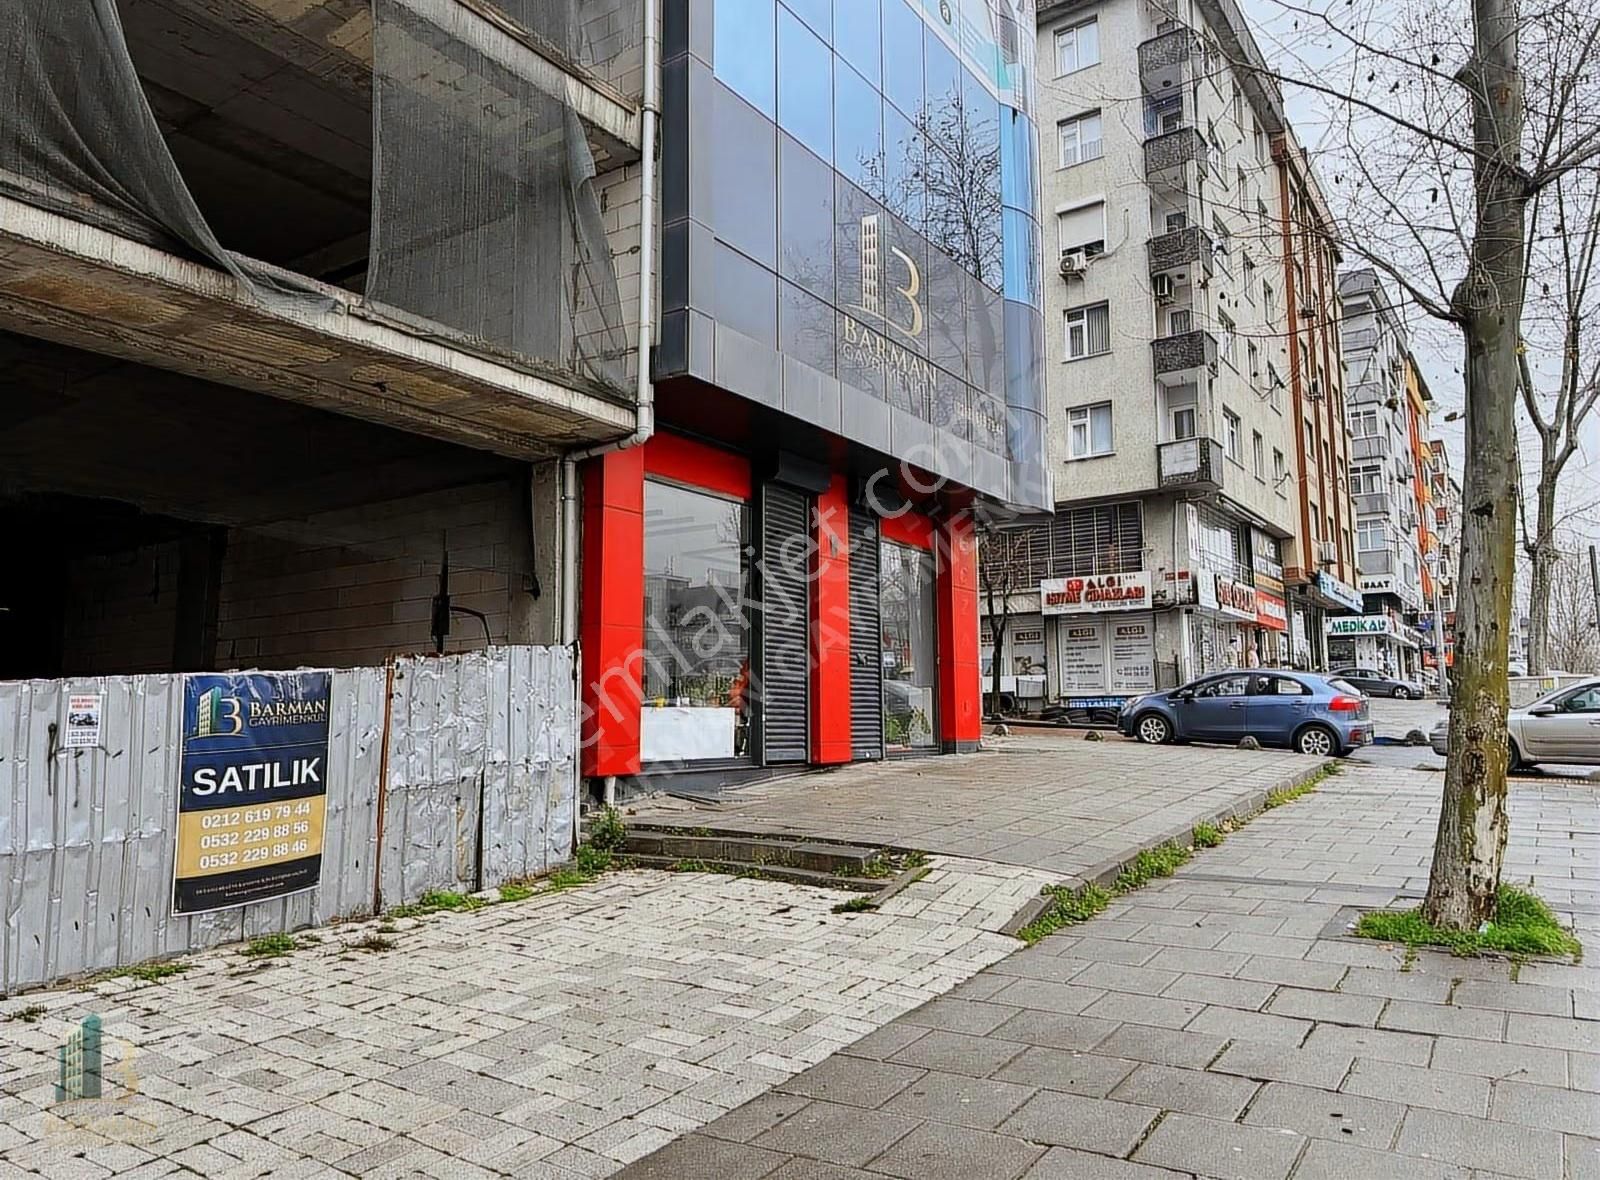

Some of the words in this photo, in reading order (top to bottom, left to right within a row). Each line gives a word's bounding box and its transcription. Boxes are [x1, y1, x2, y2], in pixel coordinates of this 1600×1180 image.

[844, 315, 937, 389] BARMAN
[1332, 618, 1385, 633] MEDİKAL
[251, 699, 326, 717] BARMAN
[192, 757, 321, 796] SATILIK
[202, 812, 240, 829] 0212
[245, 808, 271, 823] 619
[275, 805, 291, 819] 79
[295, 802, 310, 815] 44
[201, 832, 239, 849] 0532
[243, 827, 270, 843] 229
[274, 824, 289, 837] 88
[200, 851, 238, 868] 0532
[242, 847, 269, 863] 229
[273, 843, 288, 857] 88
[292, 839, 308, 852] 46
